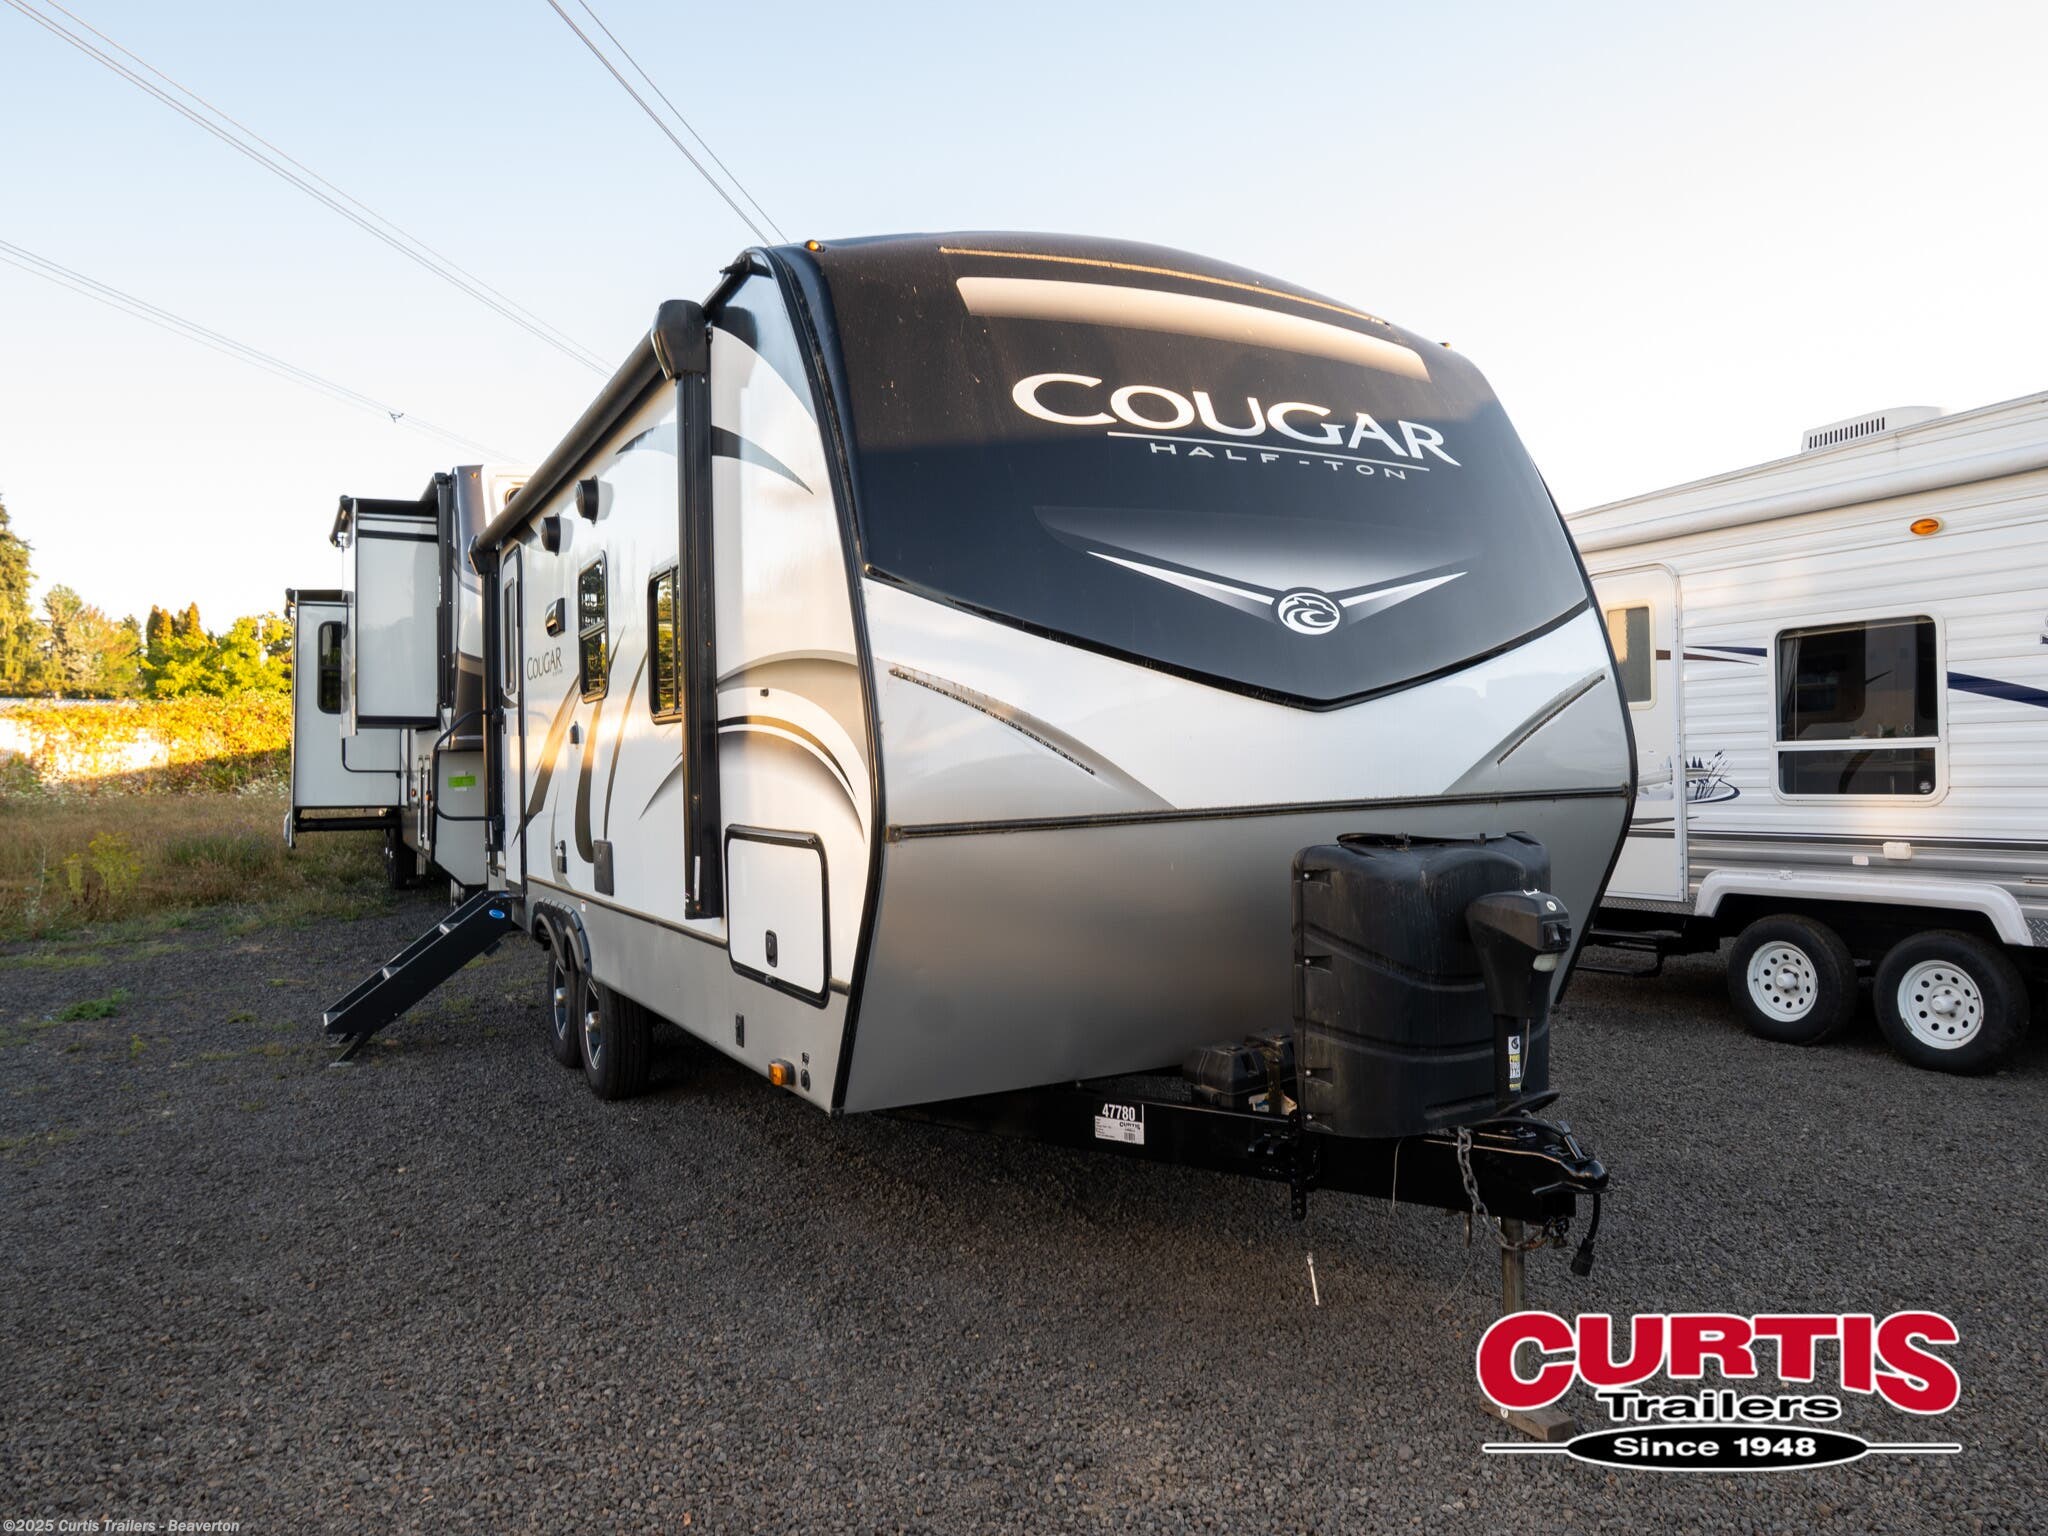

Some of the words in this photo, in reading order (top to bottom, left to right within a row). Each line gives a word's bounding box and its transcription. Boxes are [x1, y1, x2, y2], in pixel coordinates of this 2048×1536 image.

[1011, 372, 1462, 467] COUGAR
[1150, 442, 1407, 481] HALF-TON
[526, 646, 562, 681] COUGAR
[1102, 1103, 1136, 1122] 47780
